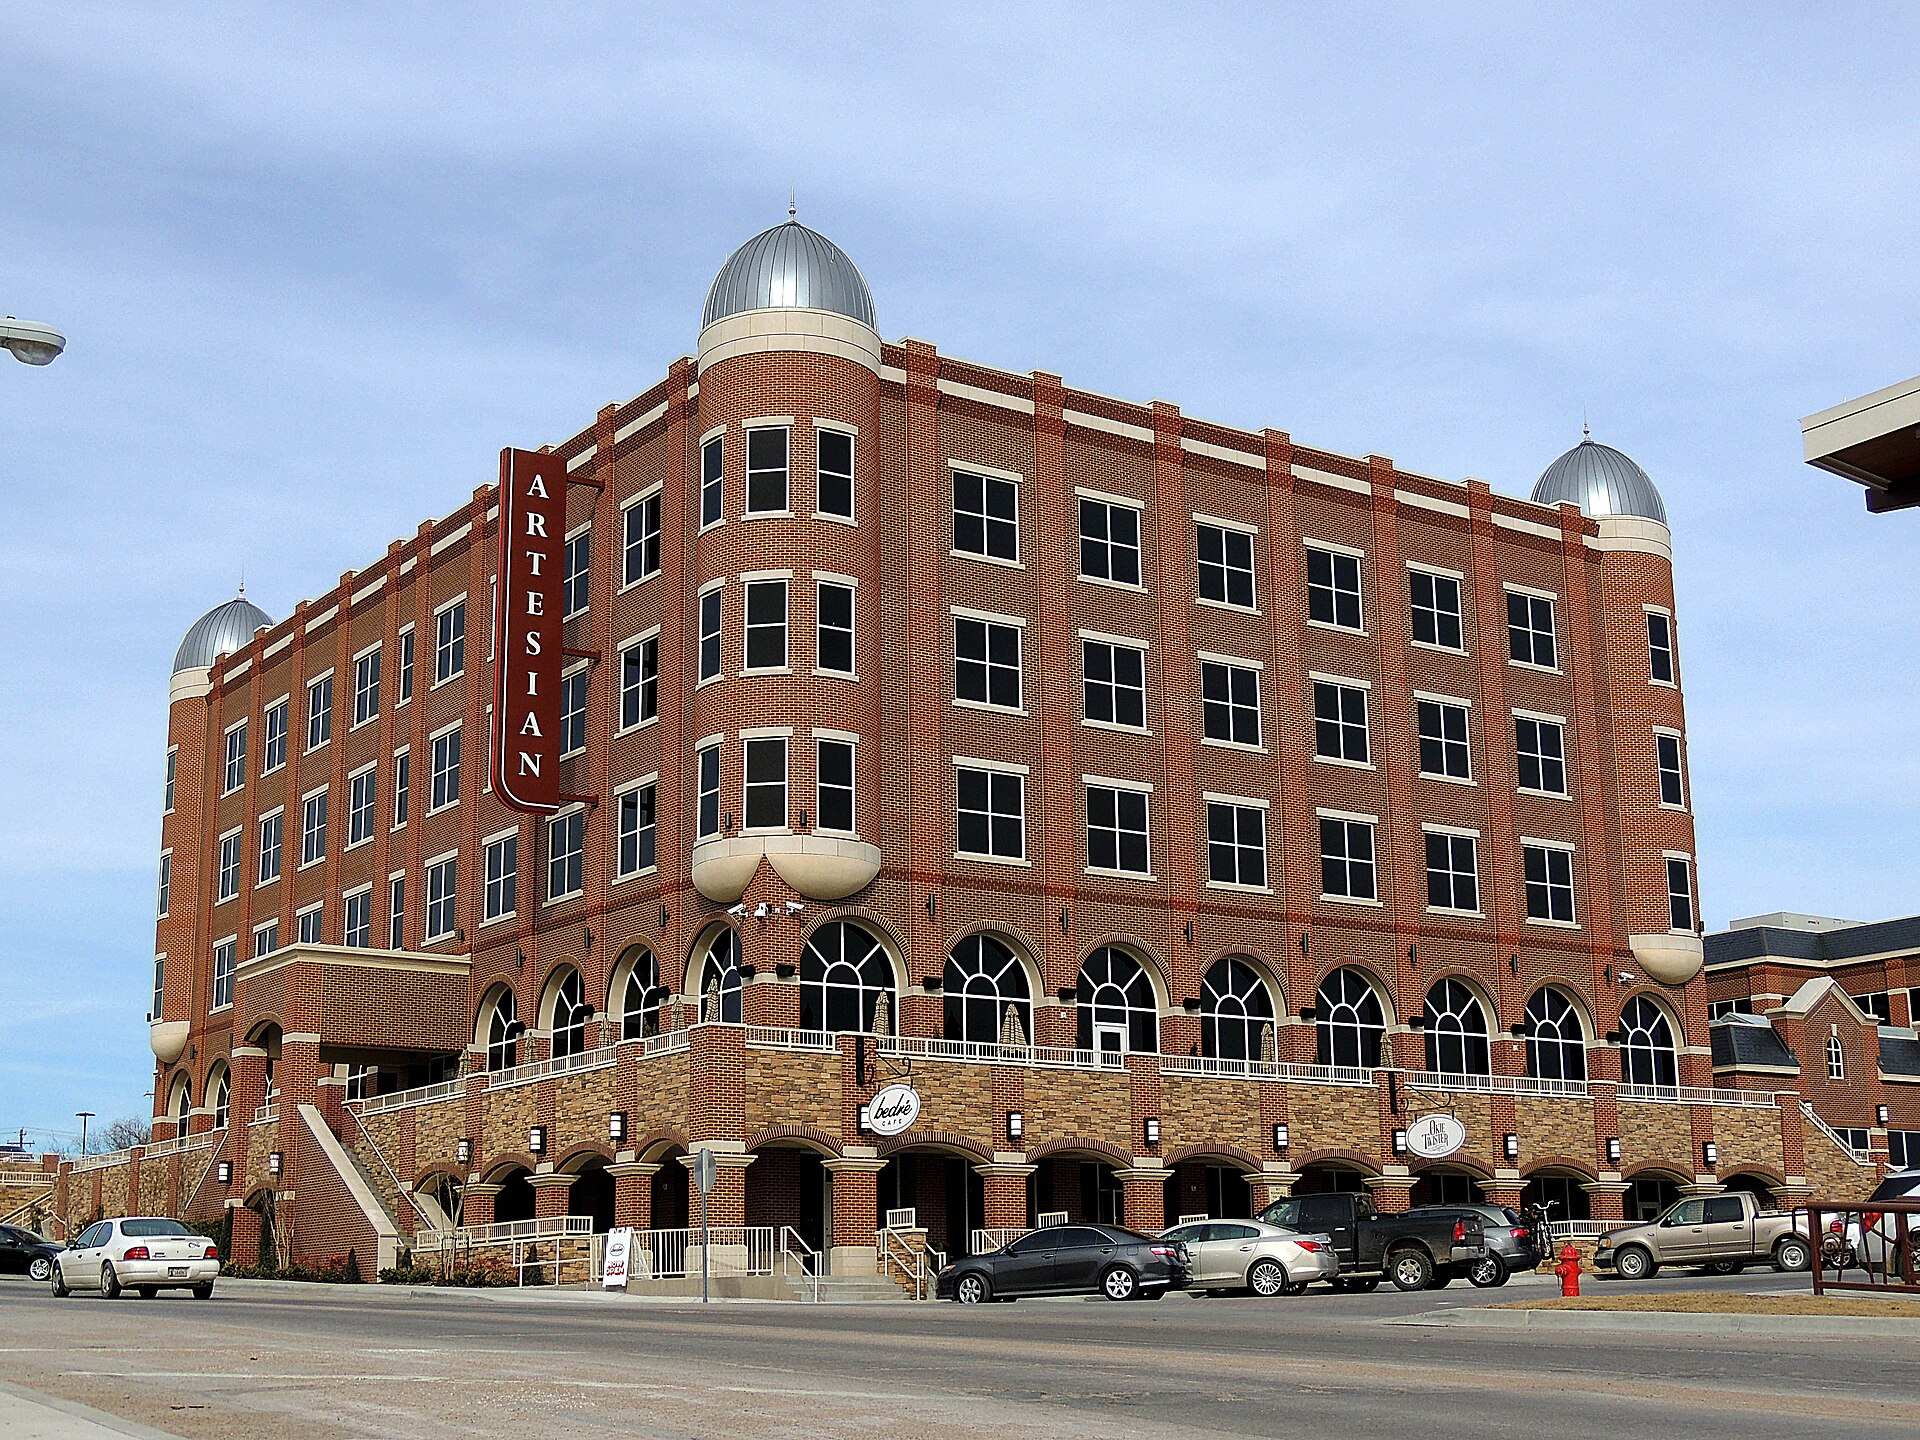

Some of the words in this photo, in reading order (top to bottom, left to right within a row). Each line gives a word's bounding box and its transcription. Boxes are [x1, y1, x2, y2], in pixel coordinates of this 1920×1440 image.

[518, 474, 550, 778] ARTESIAN
[873, 1093, 913, 1120] bedré
[881, 1118, 903, 1127] CAFE
